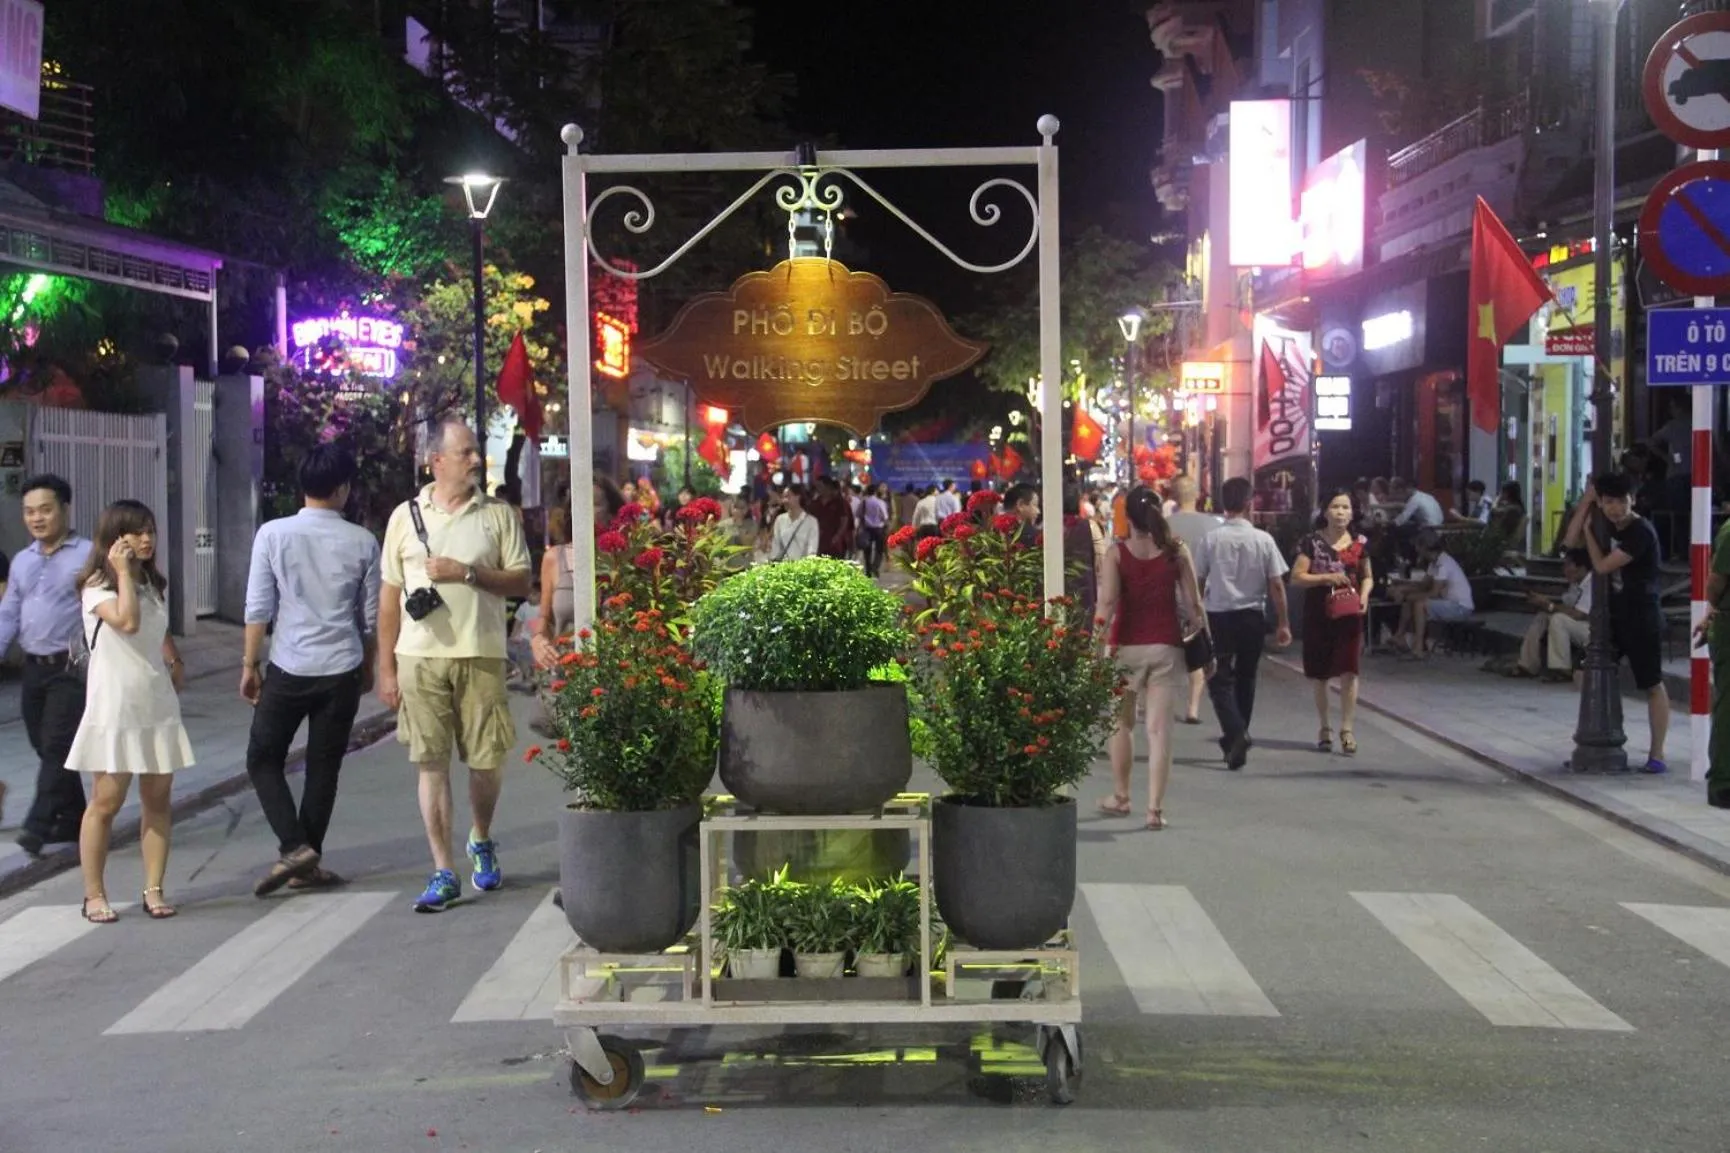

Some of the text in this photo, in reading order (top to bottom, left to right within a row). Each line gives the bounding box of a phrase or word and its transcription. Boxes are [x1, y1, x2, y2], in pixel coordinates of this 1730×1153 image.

[0, 0, 38, 81] NG
[806, 308, 836, 336] ĐI
[848, 304, 889, 340] BỘ
[1687, 319, 1726, 344] Ô TÔ
[703, 353, 921, 386] Walking Street
[1655, 350, 1701, 373] TRÊN
[1706, 354, 1718, 372] 9
[1269, 335, 1298, 456] Tatoo
